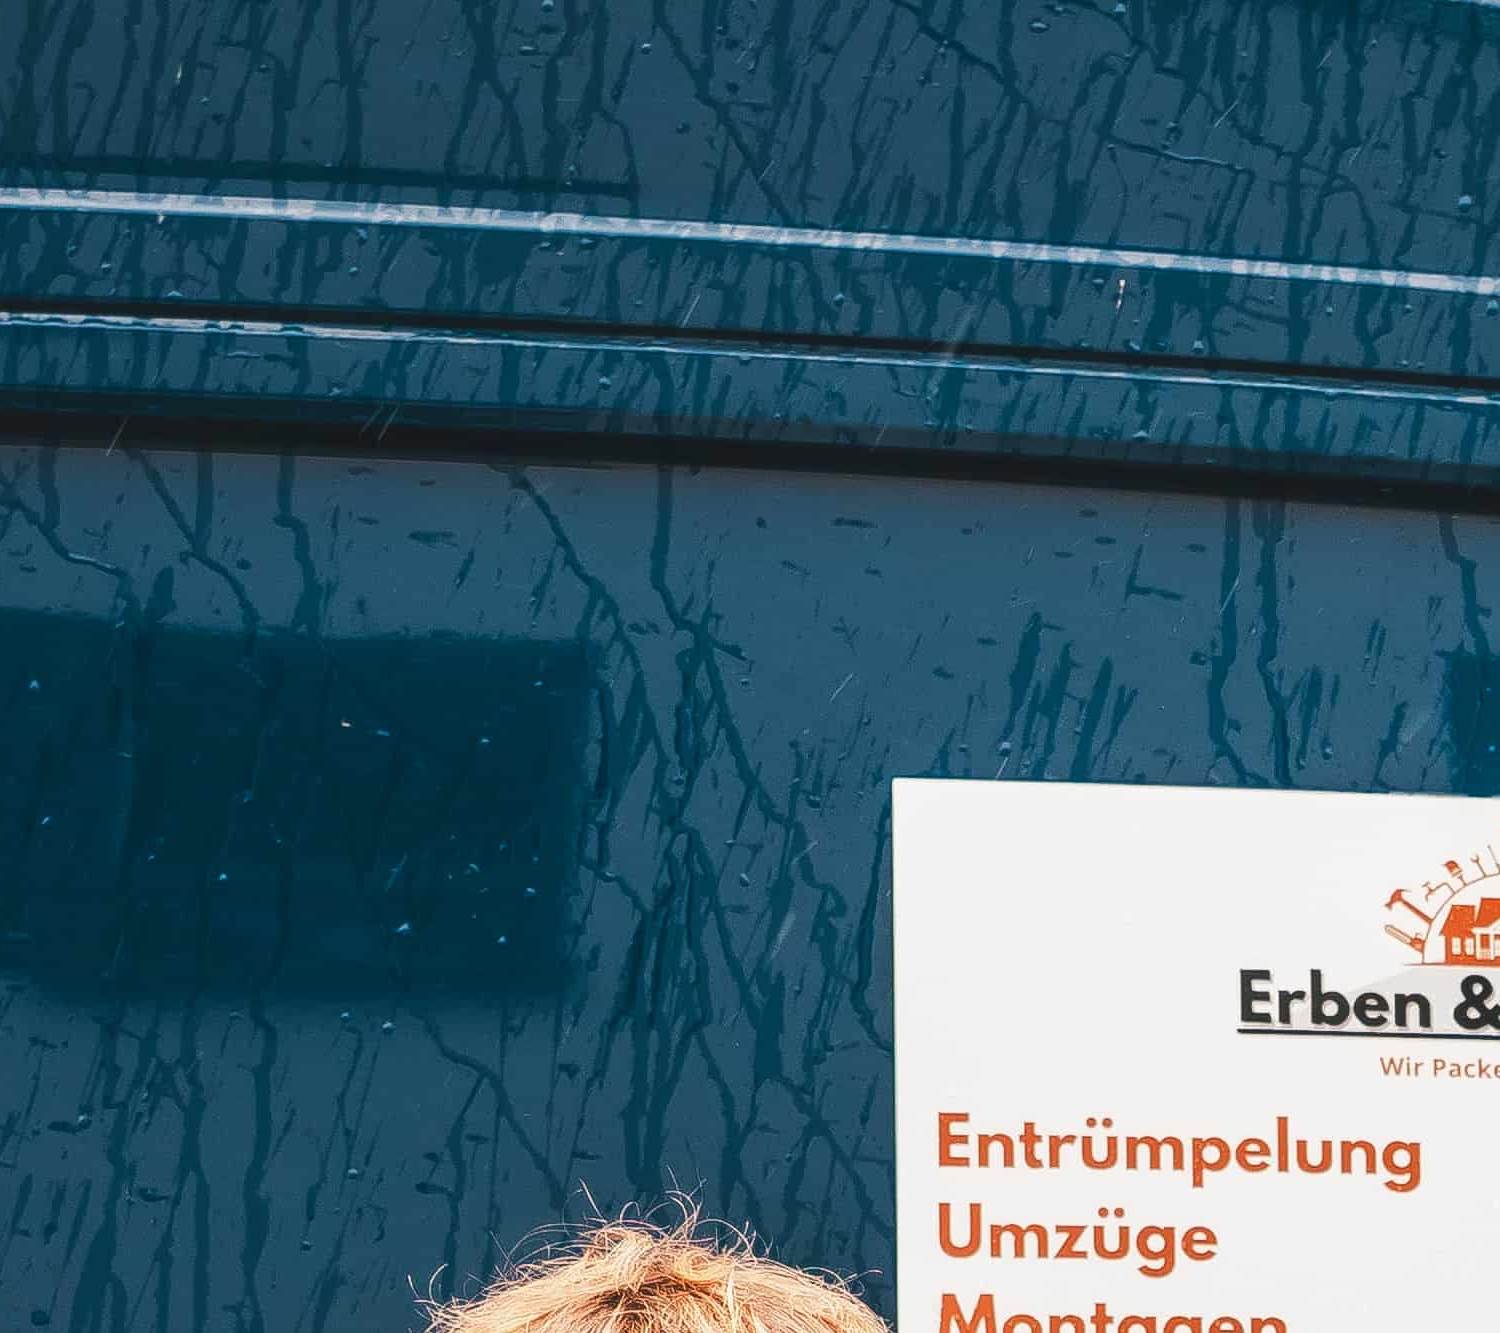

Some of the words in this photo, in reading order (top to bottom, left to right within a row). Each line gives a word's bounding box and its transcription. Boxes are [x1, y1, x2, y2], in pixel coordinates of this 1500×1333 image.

[1238, 967, 1432, 1030] Erben
[1378, 1055, 1426, 1078] Wir
[937, 1110, 1424, 1194] Entrümpelung
[937, 1201, 1219, 1279] Umzüge
